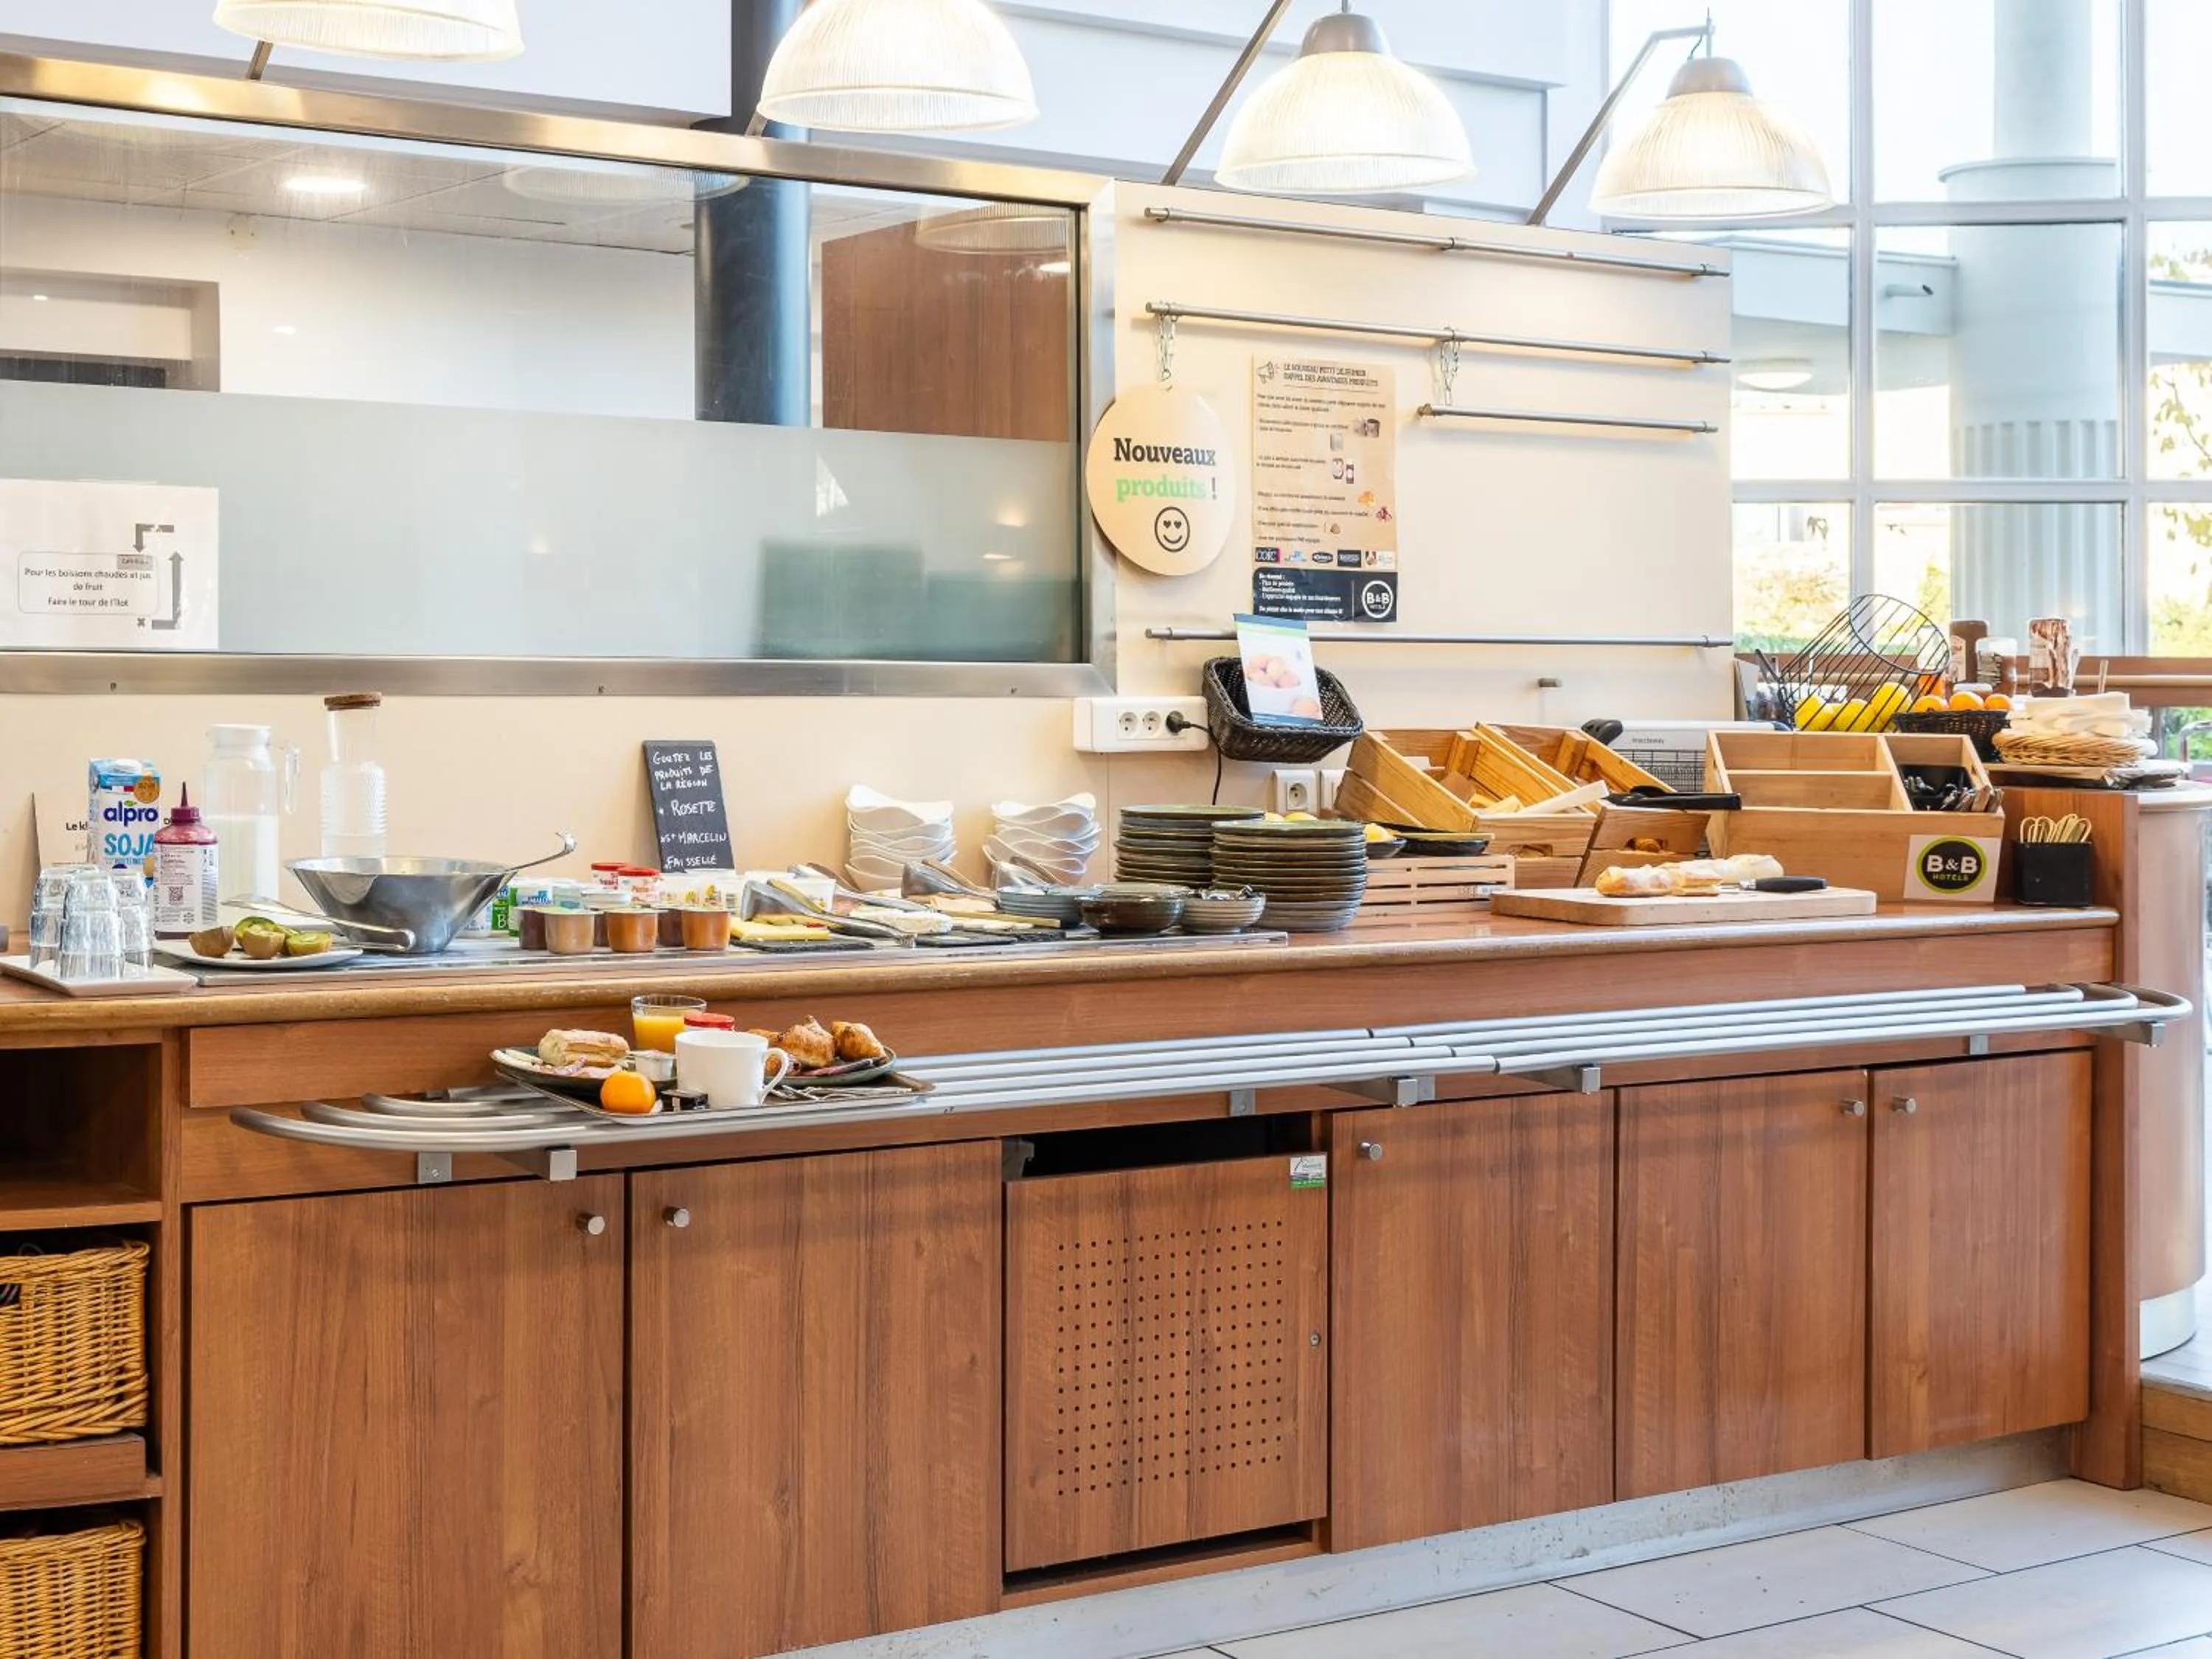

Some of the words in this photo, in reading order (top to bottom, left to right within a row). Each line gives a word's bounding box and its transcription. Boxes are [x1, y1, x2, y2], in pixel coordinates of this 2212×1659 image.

[1113, 438, 1216, 466] Nouveaux
[1116, 474, 1206, 502] produits
[24, 567, 43, 576] Pour
[45, 568, 56, 577] les
[59, 569, 92, 577] boissons
[94, 571, 128, 579] chaudes
[139, 572, 152, 580] jus
[85, 582, 103, 591] fruit
[48, 597, 66, 605] Faire
[79, 598, 96, 606] tour
[98, 598, 108, 607] de
[1367, 592, 1390, 605] B&B
[700, 751, 713, 761] LES
[654, 766, 692, 782] PRODUITS
[699, 765, 714, 776] DE
[660, 781, 672, 791] LA
[103, 801, 159, 827] alpro
[66, 822, 77, 830] Le
[678, 831, 727, 844] MARCELIN
[104, 833, 154, 856] SOJA
[1927, 855, 1978, 874] B&B
